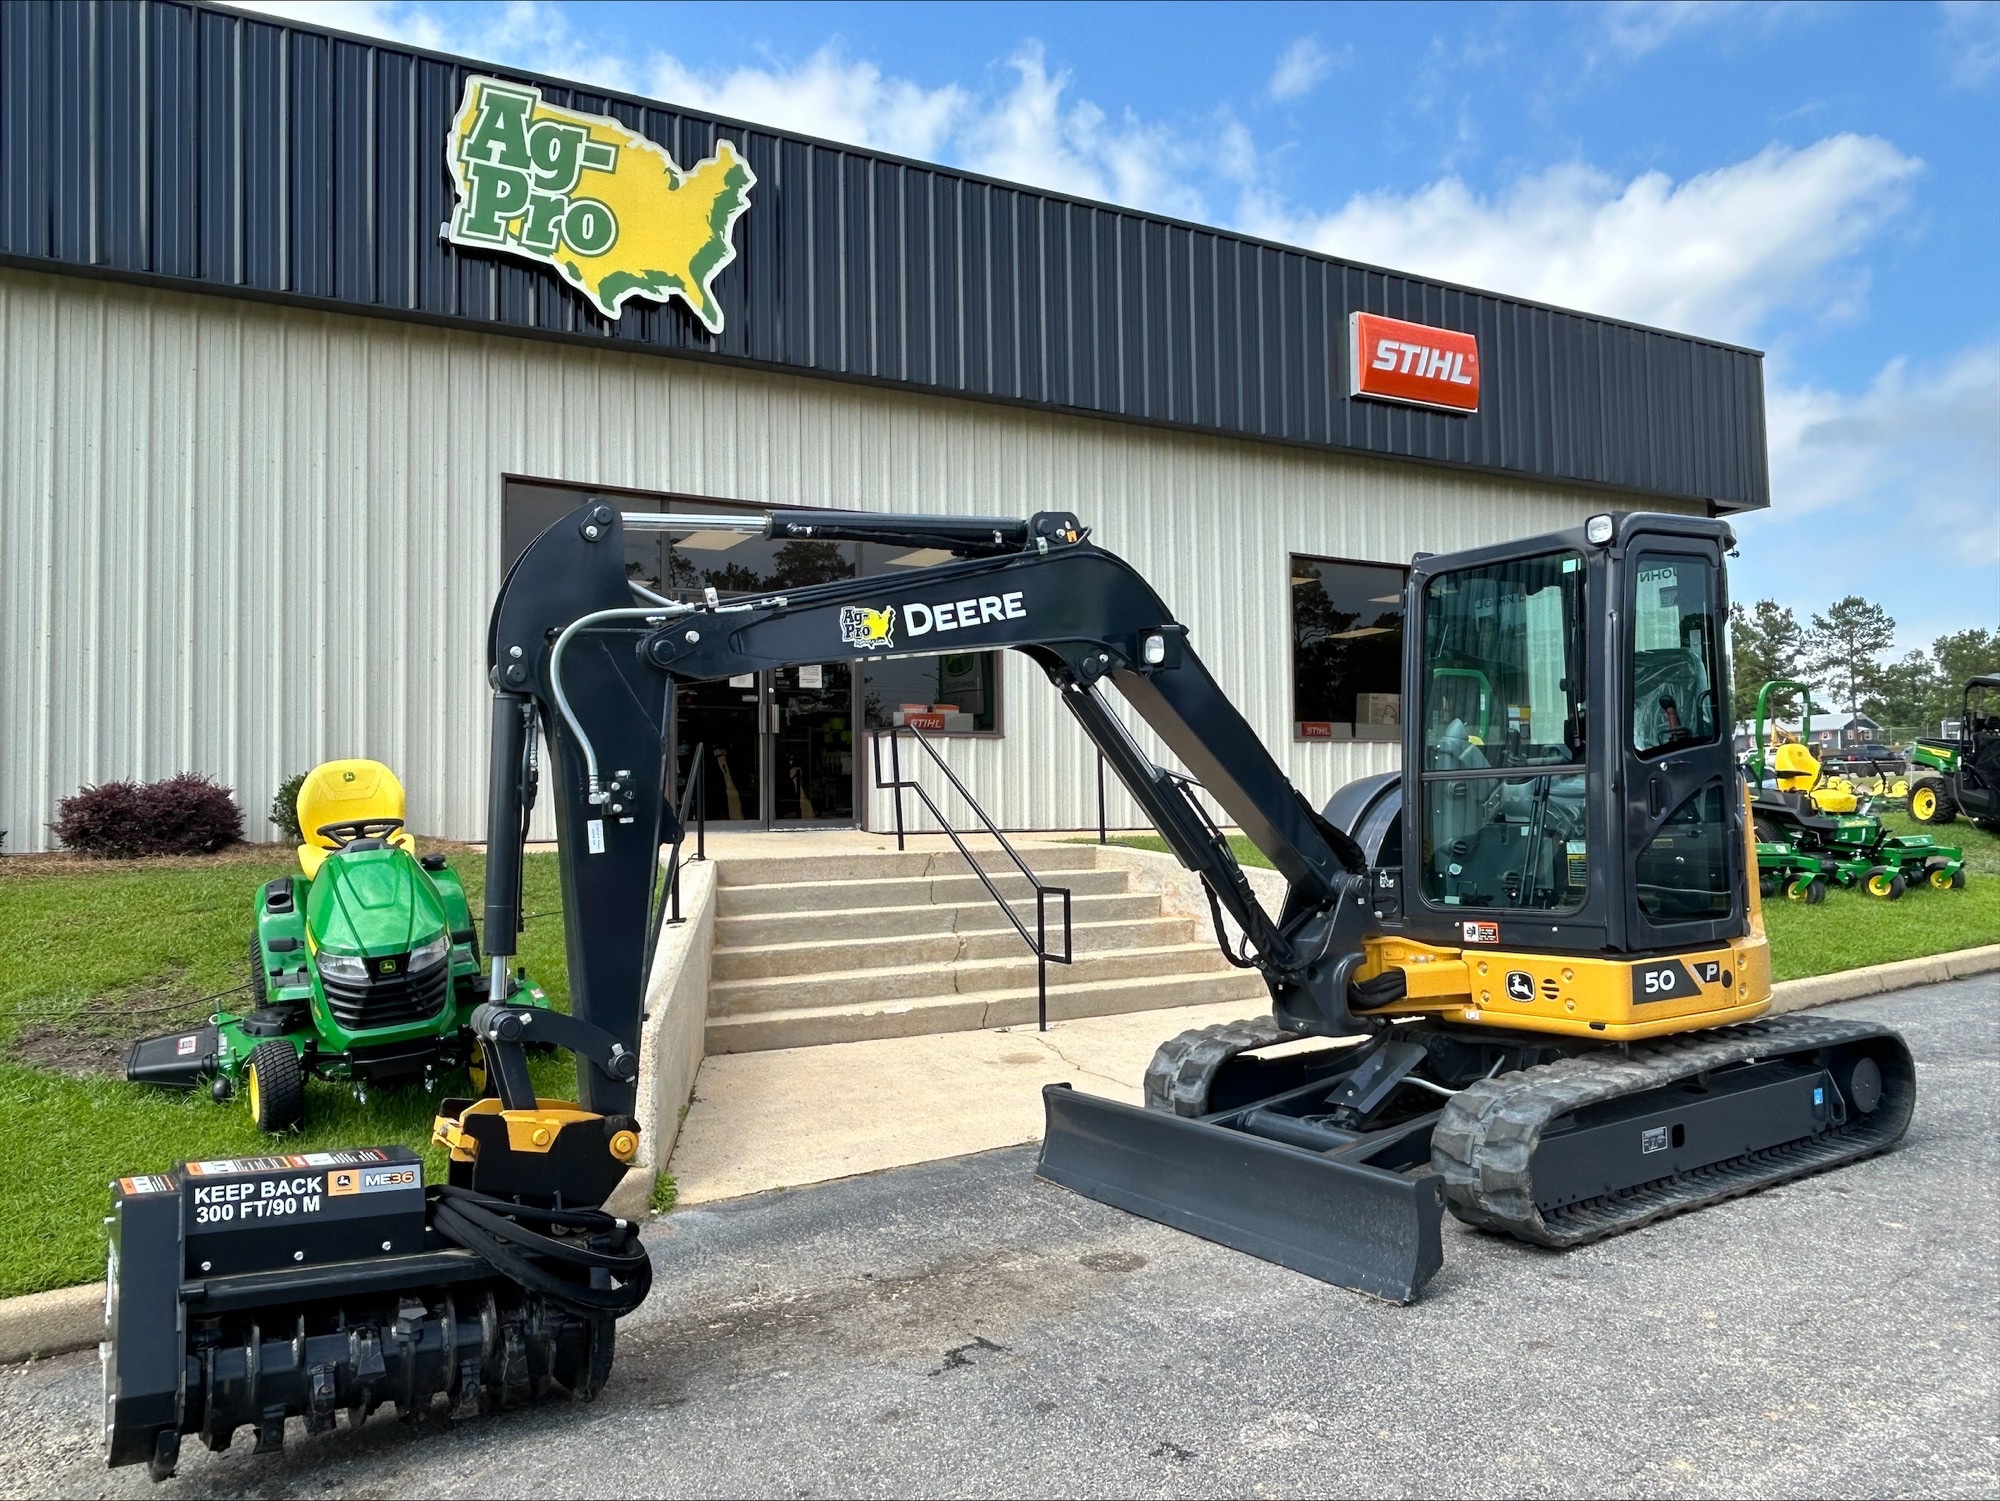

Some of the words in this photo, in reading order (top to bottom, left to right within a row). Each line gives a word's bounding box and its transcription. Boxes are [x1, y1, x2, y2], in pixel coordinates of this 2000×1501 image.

[463, 86, 617, 193] Ag-
[463, 161, 617, 255] Pro
[1372, 339, 1472, 385] STIHL
[844, 609, 869, 625] Ag-
[902, 591, 1026, 637] DEERE
[845, 624, 870, 638] Pro
[1306, 726, 1330, 735] STIHL
[1645, 969, 1676, 993] 50
[1706, 963, 1718, 981] P
[194, 1183, 255, 1205] KEEP
[260, 1176, 322, 1198] BACK
[365, 1171, 414, 1187] ME36
[196, 1203, 234, 1223] 300
[240, 1197, 297, 1219] FT/90
[303, 1194, 320, 1212] M
